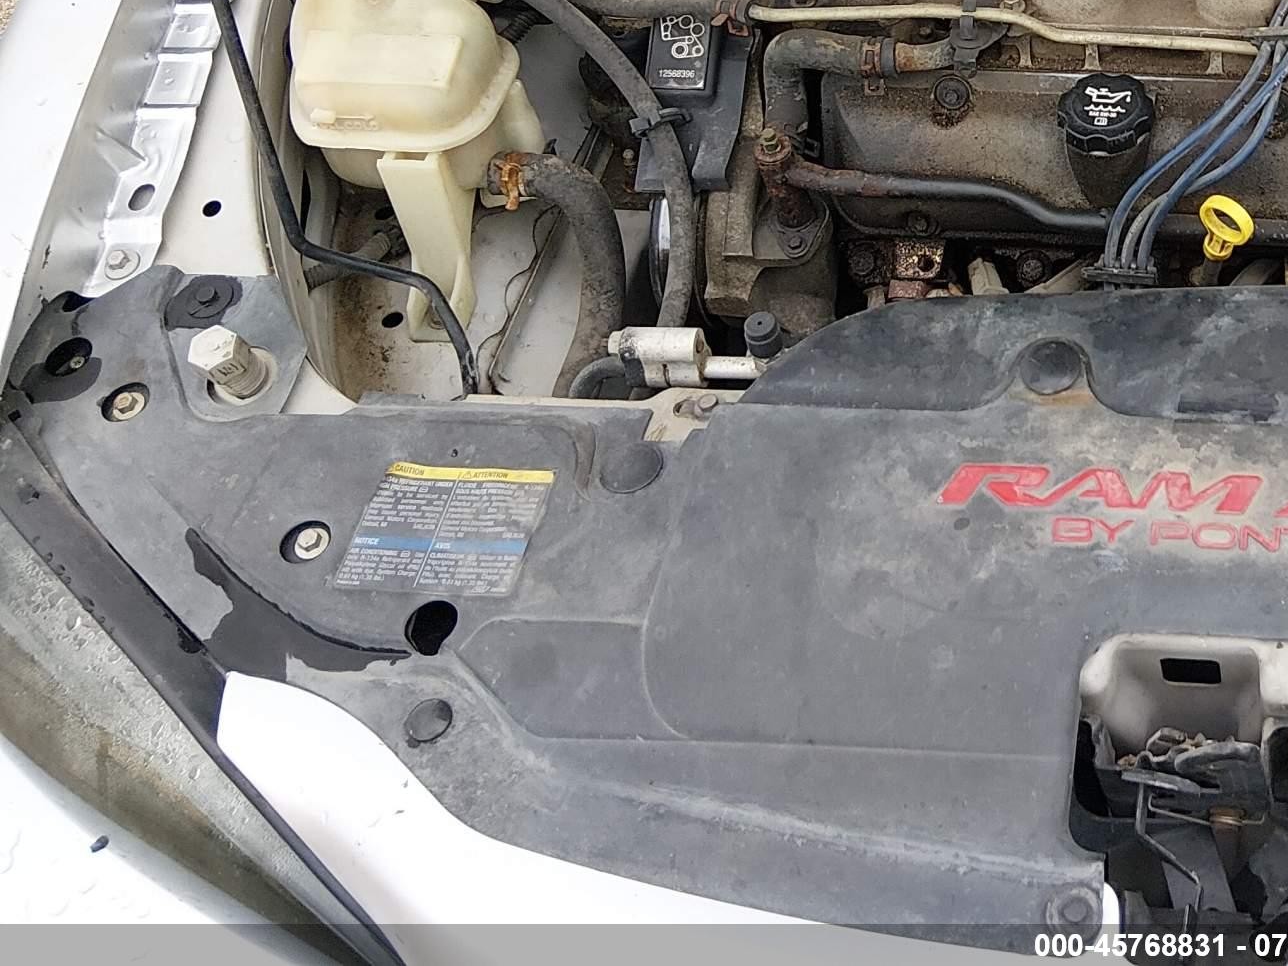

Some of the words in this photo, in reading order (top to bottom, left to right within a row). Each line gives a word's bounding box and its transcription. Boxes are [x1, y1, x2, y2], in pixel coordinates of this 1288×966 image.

[659, 70, 695, 78] 12568396
[395, 464, 425, 476] CAUTION
[937, 464, 1263, 512] RAM
[1052, 517, 1136, 544] BY
[354, 537, 379, 545] NOTICE
